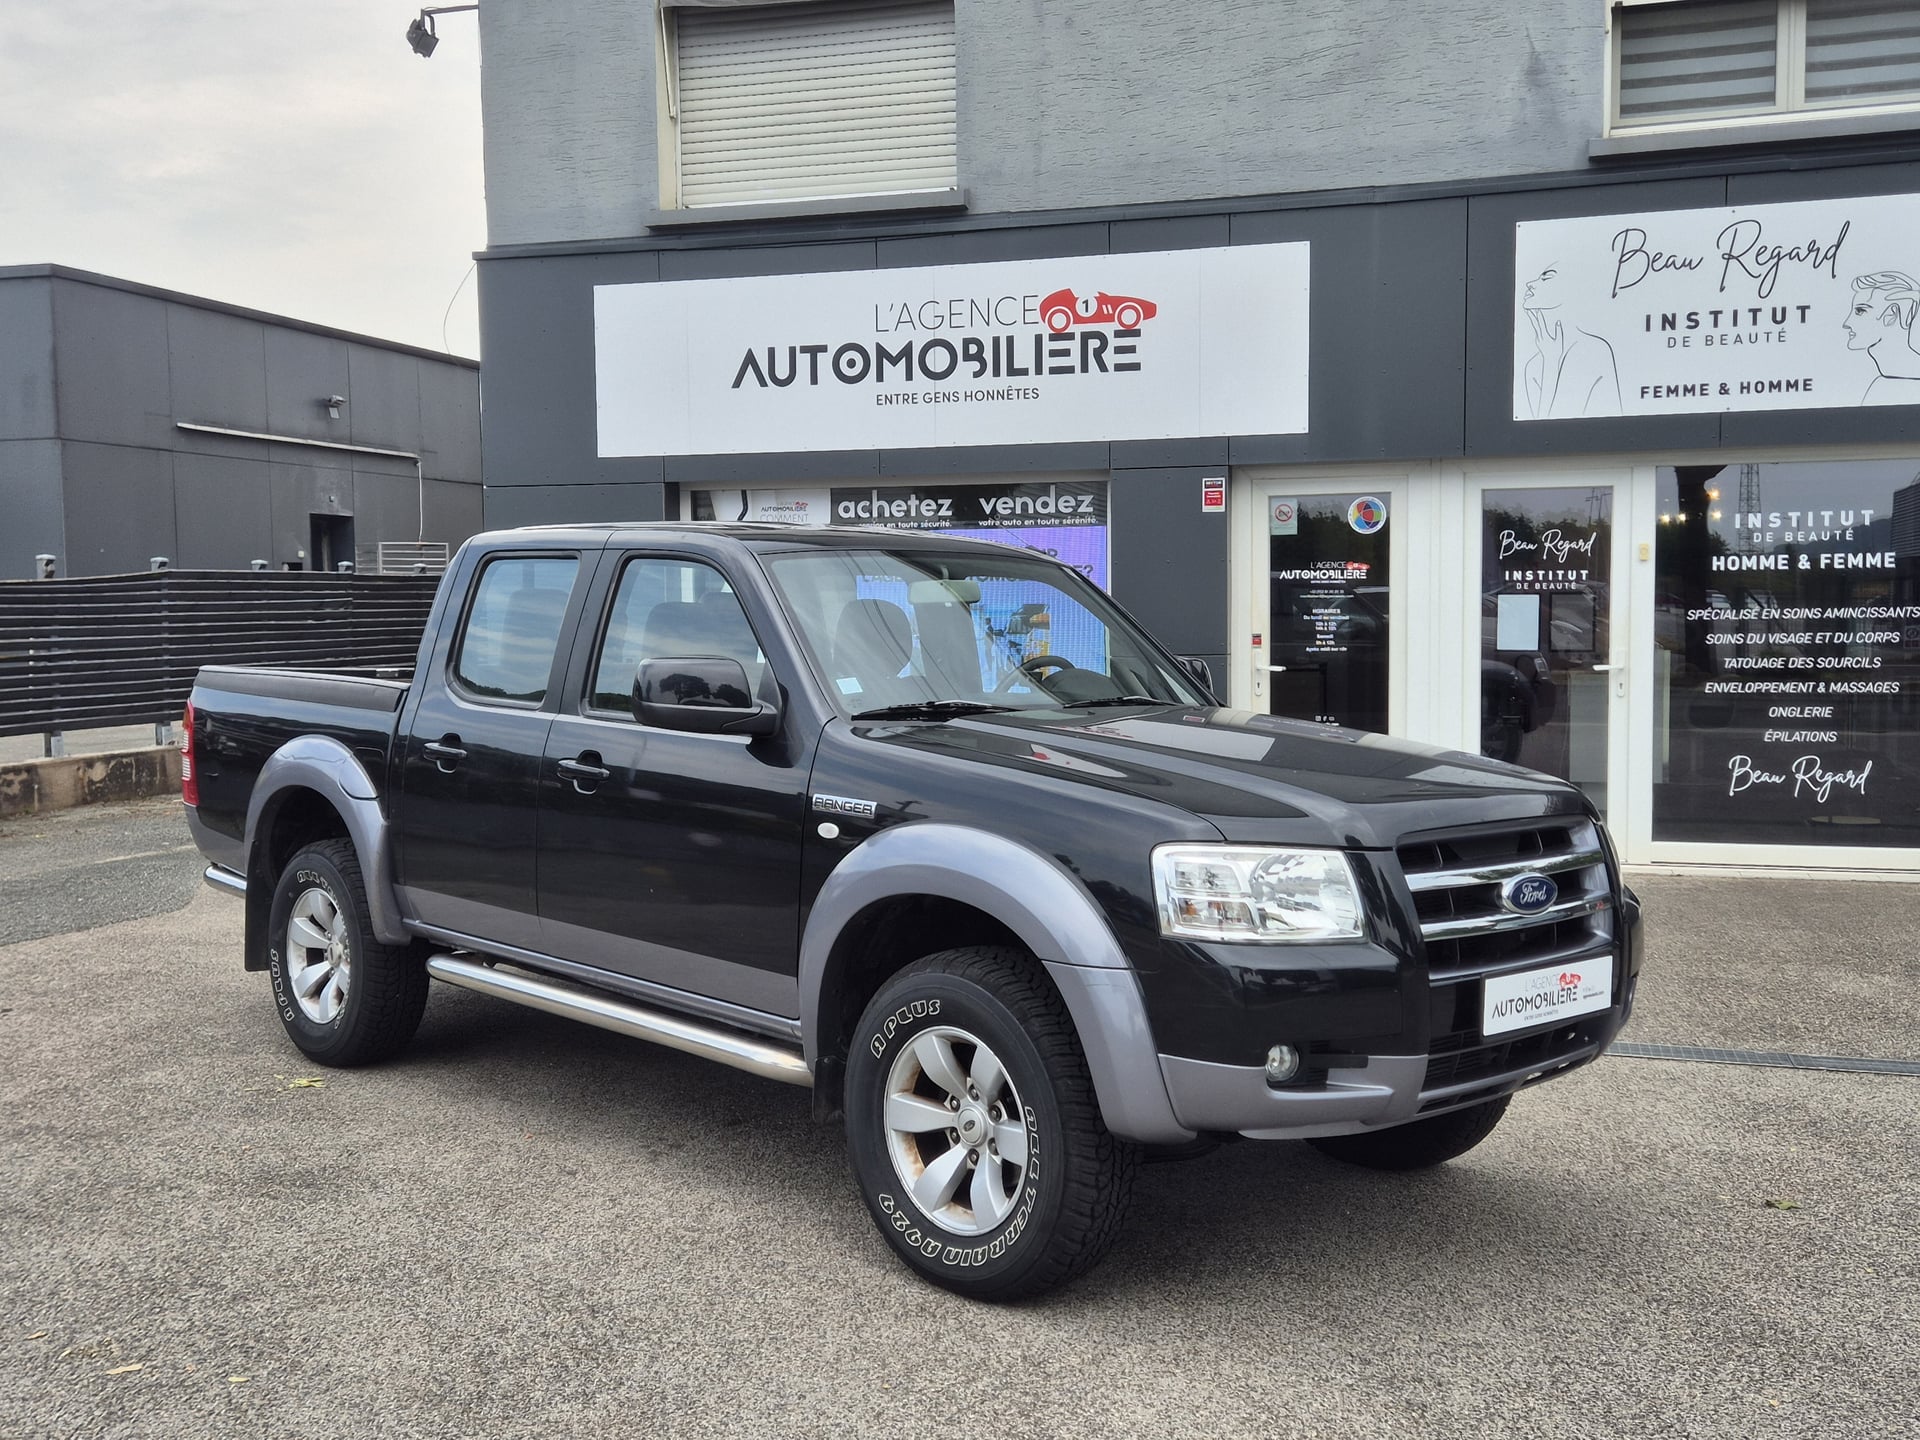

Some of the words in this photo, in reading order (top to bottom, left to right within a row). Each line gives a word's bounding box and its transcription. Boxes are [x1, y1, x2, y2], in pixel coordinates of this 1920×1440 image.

[1611, 228, 1704, 299] Beau
[1716, 219, 1851, 299] Regard
[874, 294, 1039, 332] L'AGENCE
[1645, 304, 1811, 332] INSTITUT
[1667, 335, 1691, 349] DE
[1704, 327, 1788, 347] BEAUTÉ
[876, 393, 919, 406] ENTRE
[923, 391, 960, 404] GENS
[964, 386, 1040, 402] HONNÊTES
[1640, 383, 1710, 399] FEMME
[1718, 382, 1731, 396] &
[1739, 378, 1814, 395] HOMME
[838, 489, 953, 519] achetez
[978, 485, 1094, 515] vendez
[898, 520, 919, 528] toute
[978, 518, 1000, 526] votre
[1002, 517, 1022, 526] auto
[1024, 518, 1035, 526] en
[1037, 516, 1060, 525] toute
[1734, 510, 1875, 529] INSTITUT
[1753, 532, 1774, 543] DE
[1784, 528, 1854, 542] BEAUTÉ
[1499, 529, 1538, 560] Beau
[1541, 529, 1597, 563] Regard
[1712, 555, 1789, 571] HOMME
[1797, 554, 1811, 570] &
[1820, 552, 1896, 569] FEMME
[1505, 570, 1589, 581] INSTITUT
[1516, 582, 1529, 590] DE
[1534, 581, 1577, 590] BEAUTÉ
[1762, 608, 1781, 619] EN
[1782, 607, 1822, 619] SOINS
[1823, 606, 1920, 619] AMINCISSANTS
[1705, 633, 1744, 645] SOINS
[1746, 633, 1765, 644] DU
[1768, 632, 1812, 644] VISAGE
[1815, 632, 1832, 643] ET
[1833, 632, 1853, 643] DU
[1855, 631, 1901, 643] CORPS
[1723, 657, 1785, 669] TATOUAGE
[1788, 657, 1814, 669] DES
[1815, 656, 1882, 669] SOURCILS
[1704, 682, 1816, 693] ENVELOPPEMENT
[1817, 682, 1827, 693] &
[1828, 681, 1900, 693] MASSAGES
[1768, 706, 1834, 718] ONGLERIE
[1763, 728, 1838, 742] ÉPILATIONS
[1728, 755, 1786, 797] Beau
[1792, 755, 1873, 803] Regard
[814, 797, 873, 816] RANGER
[1520, 882, 1547, 905] Ford
[870, 1034, 887, 1058] A
[883, 999, 942, 1039] PLUS
[1024, 1105, 1040, 1180] ALL
[878, 1193, 942, 1258] A929
[942, 1186, 1037, 1266] TERRAIN
